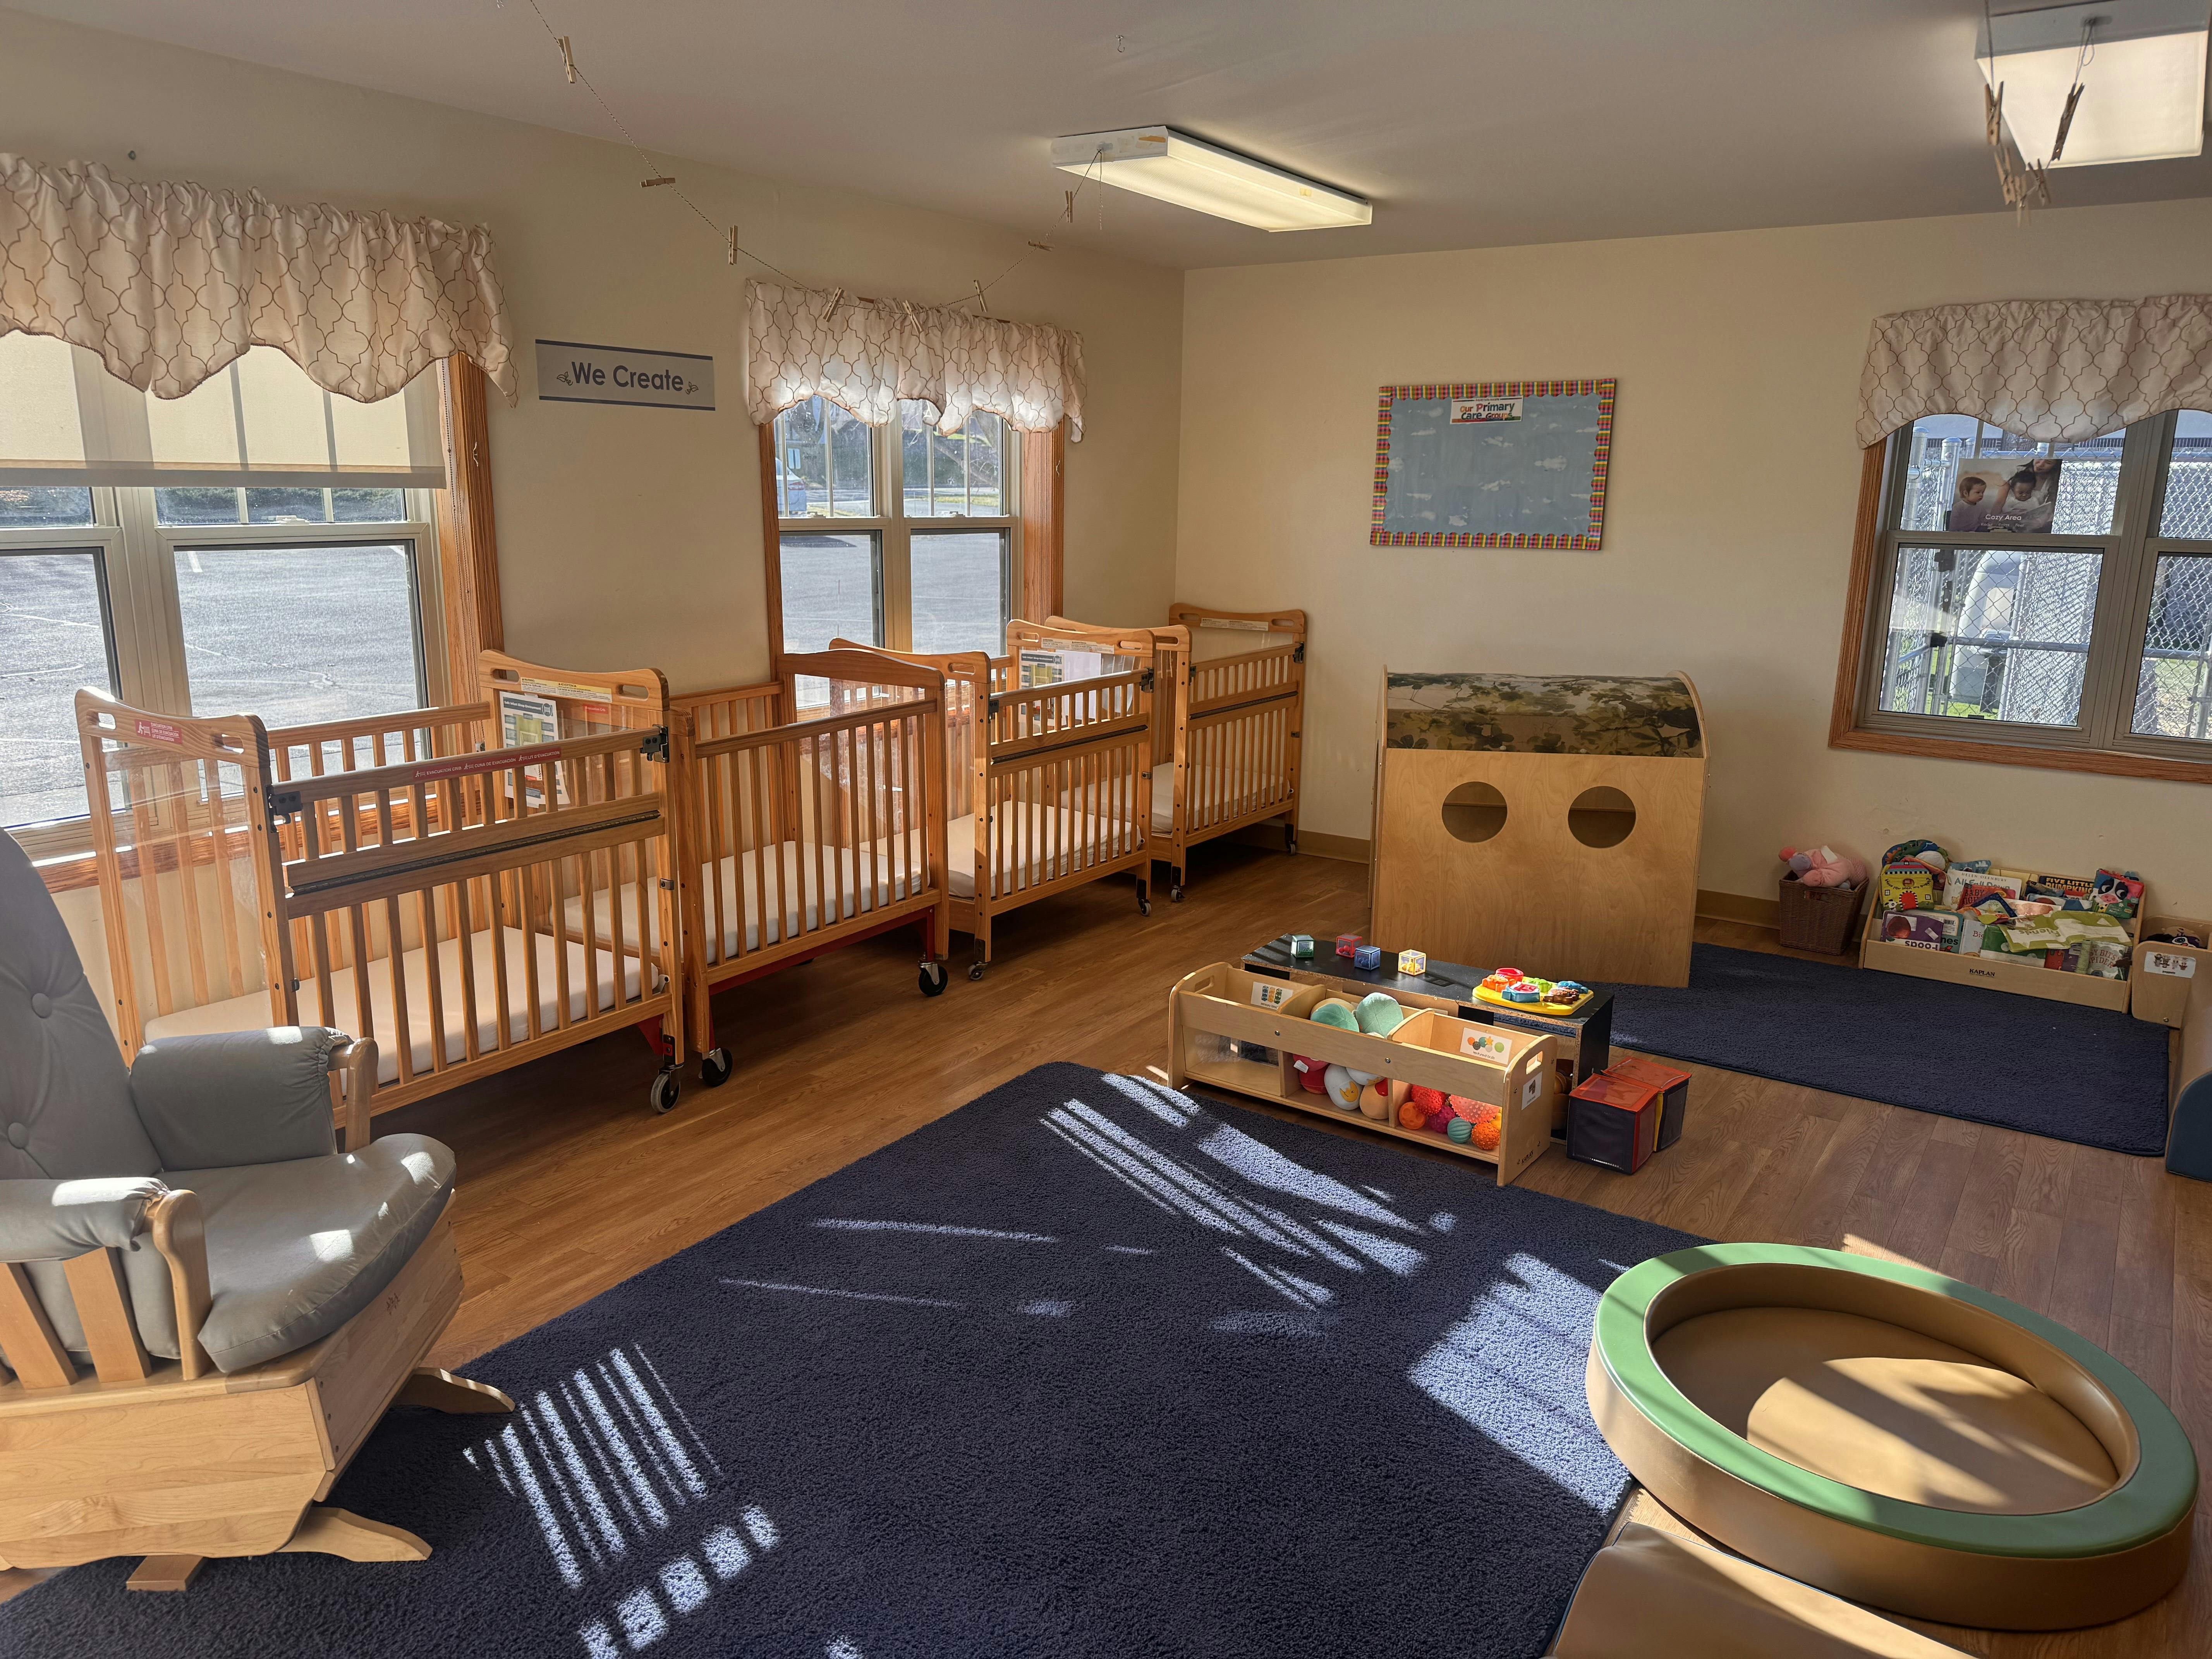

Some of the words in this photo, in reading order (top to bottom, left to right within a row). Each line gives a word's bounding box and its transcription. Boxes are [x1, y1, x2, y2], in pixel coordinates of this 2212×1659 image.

[572, 361, 606, 385] We
[613, 365, 684, 391] Create
[1476, 402, 1515, 412] Primary
[1954, 877, 1966, 886] All
[1970, 969, 1995, 977] KAPLAN
